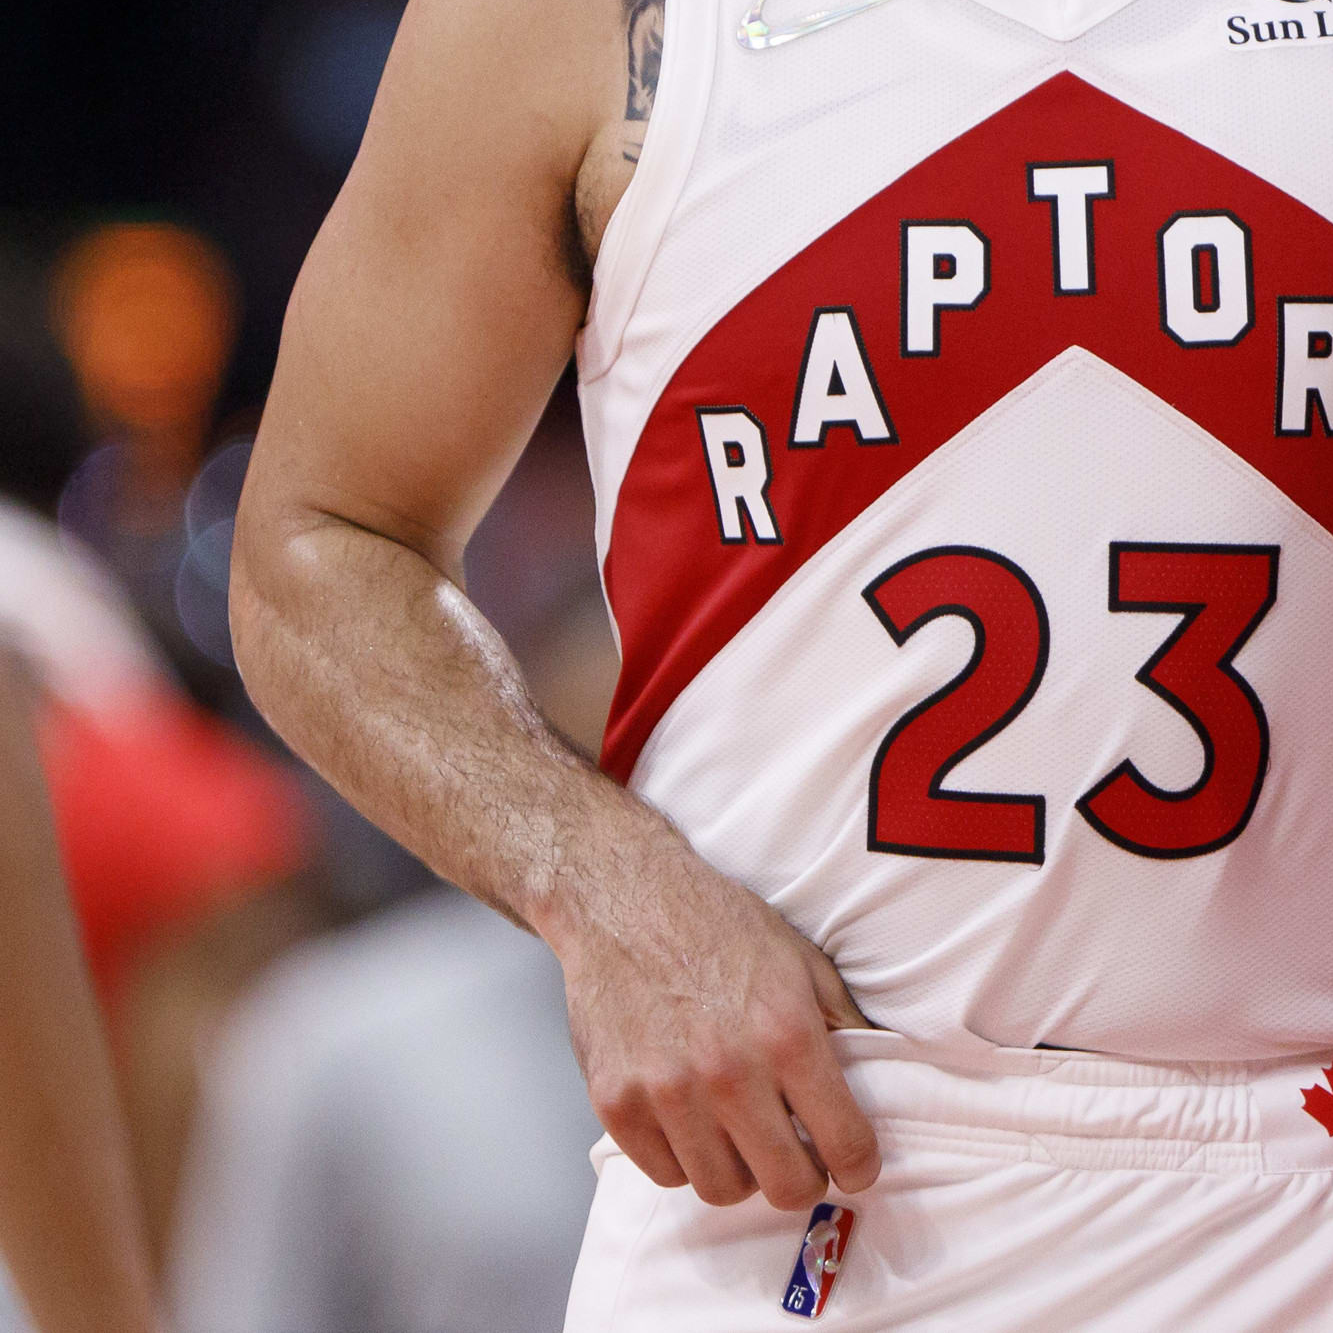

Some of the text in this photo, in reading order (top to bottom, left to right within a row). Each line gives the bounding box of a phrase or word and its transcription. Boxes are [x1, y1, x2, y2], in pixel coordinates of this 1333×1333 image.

[1226, 15, 1307, 46] Sun
[862, 540, 1282, 867] 23
[787, 1284, 808, 1310] 75
